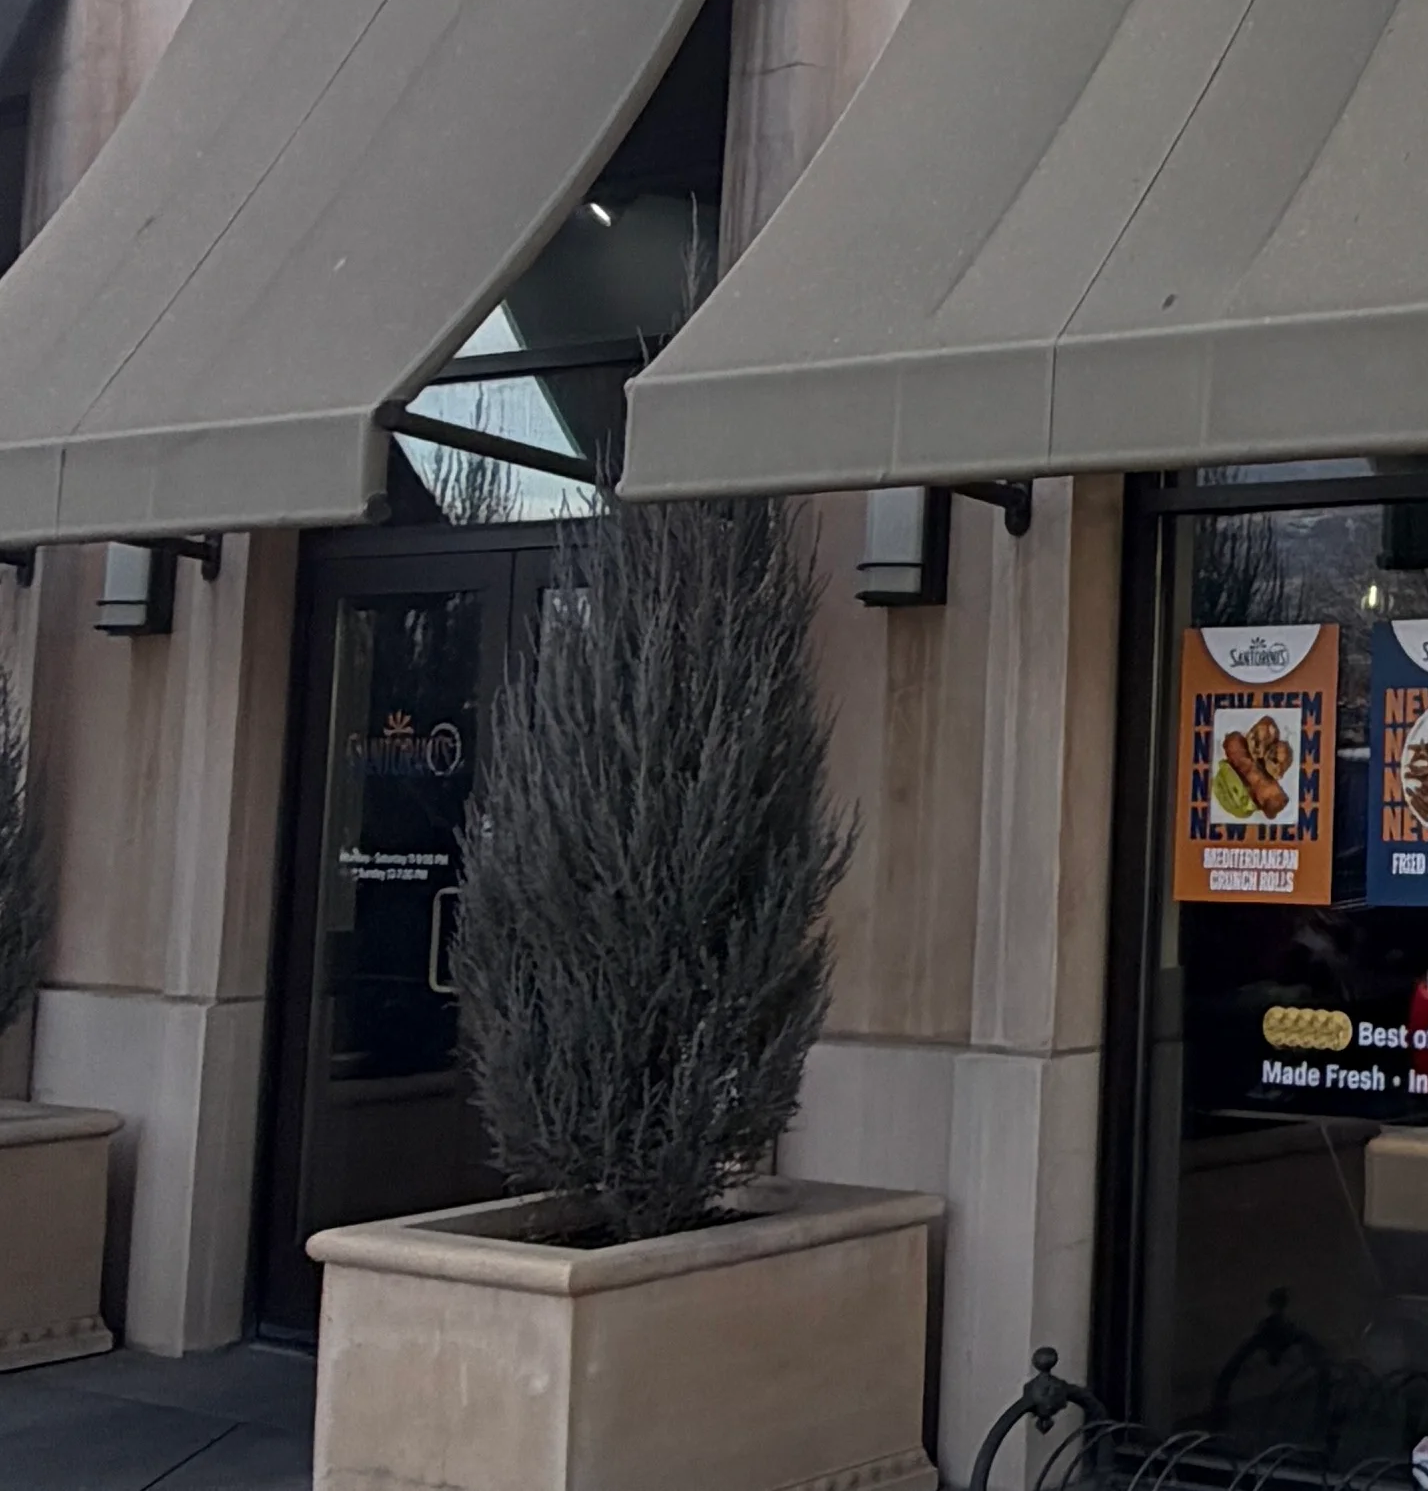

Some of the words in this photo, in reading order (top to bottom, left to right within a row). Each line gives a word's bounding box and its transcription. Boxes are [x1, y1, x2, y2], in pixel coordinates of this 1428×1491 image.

[1392, 852, 1425, 876] FRIED
[1259, 870, 1294, 892] ROLLS
[1358, 1022, 1408, 1051] Best
[1261, 1059, 1320, 1088] Made
[1325, 1063, 1386, 1091] Fresh
[1408, 1068, 1428, 1093] In
